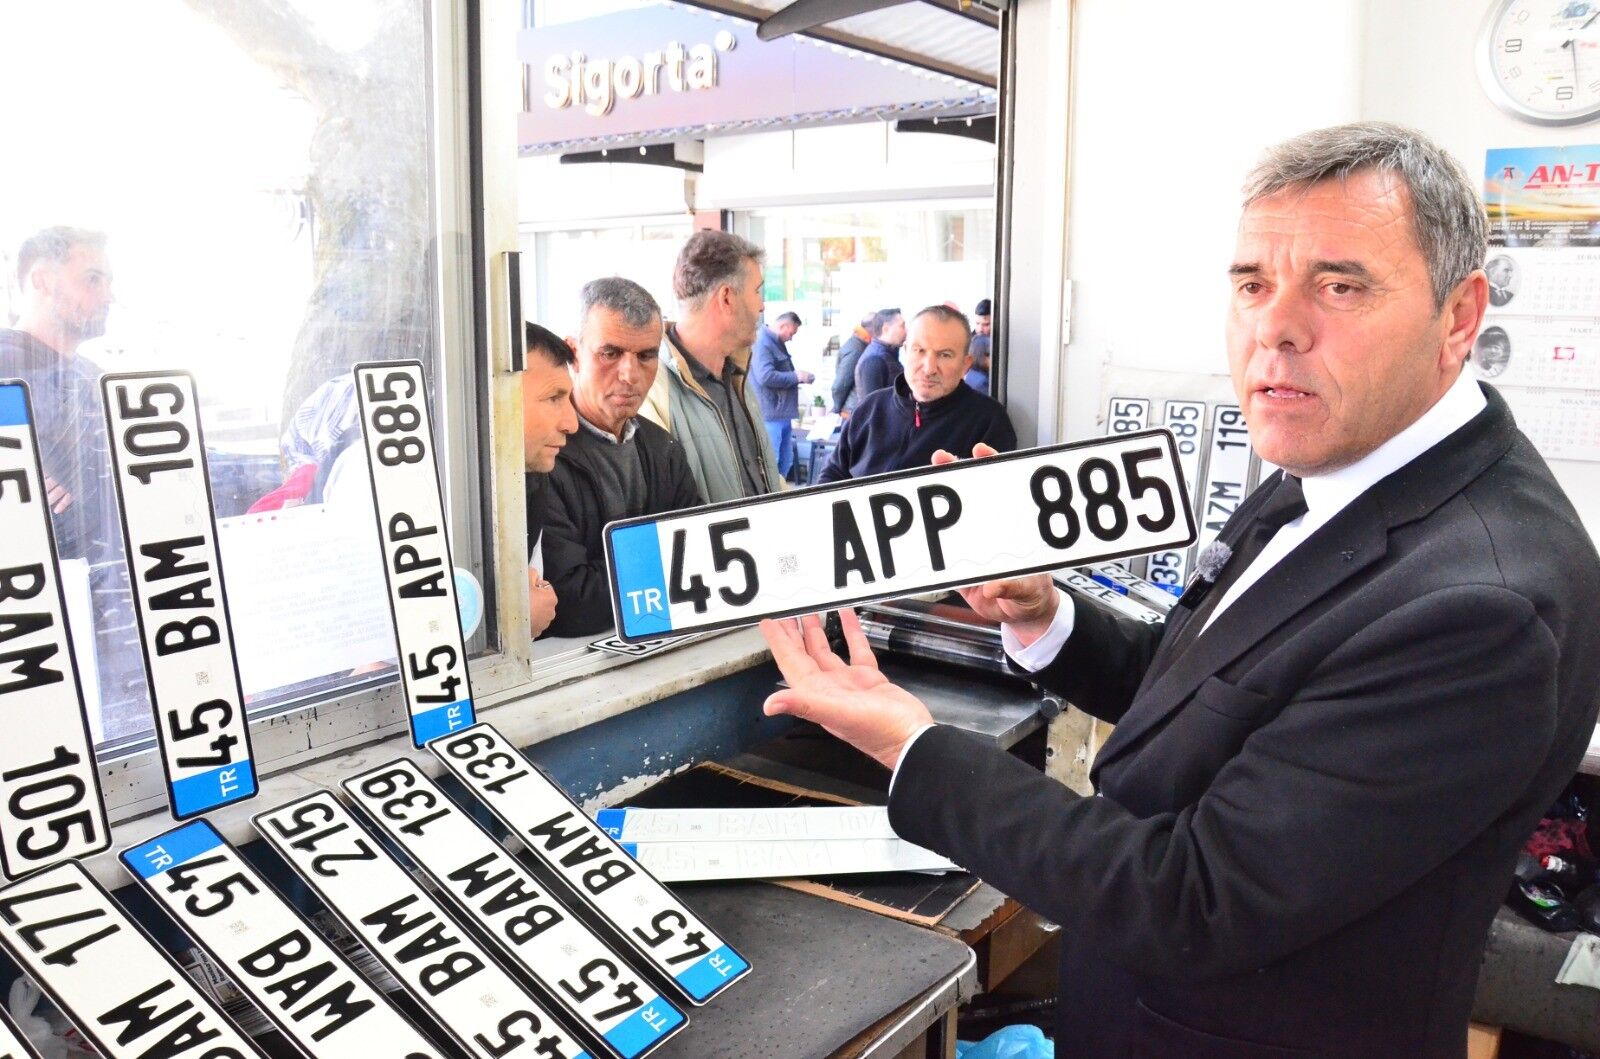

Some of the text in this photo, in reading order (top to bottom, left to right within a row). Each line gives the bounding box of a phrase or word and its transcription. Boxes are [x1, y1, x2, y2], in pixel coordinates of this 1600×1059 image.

[544, 41, 719, 117] Sigorta
[1216, 410, 1248, 451] 119
[116, 382, 239, 797] 105 BAM 45 TR
[364, 371, 462, 730] 885 APP 45 TR
[627, 447, 1176, 614] TR 45 APP 885
[1066, 575, 1124, 603] CZE
[1150, 552, 1182, 585] 35
[2, 744, 97, 861] 105
[446, 732, 733, 978] 139 BAM 45 TR
[0, 883, 121, 967] 177
[145, 844, 376, 1042] TR 45 BAM
[268, 802, 378, 877] 215
[360, 893, 486, 997] BAM
[360, 768, 668, 1033] 139 BAM 45 TR
